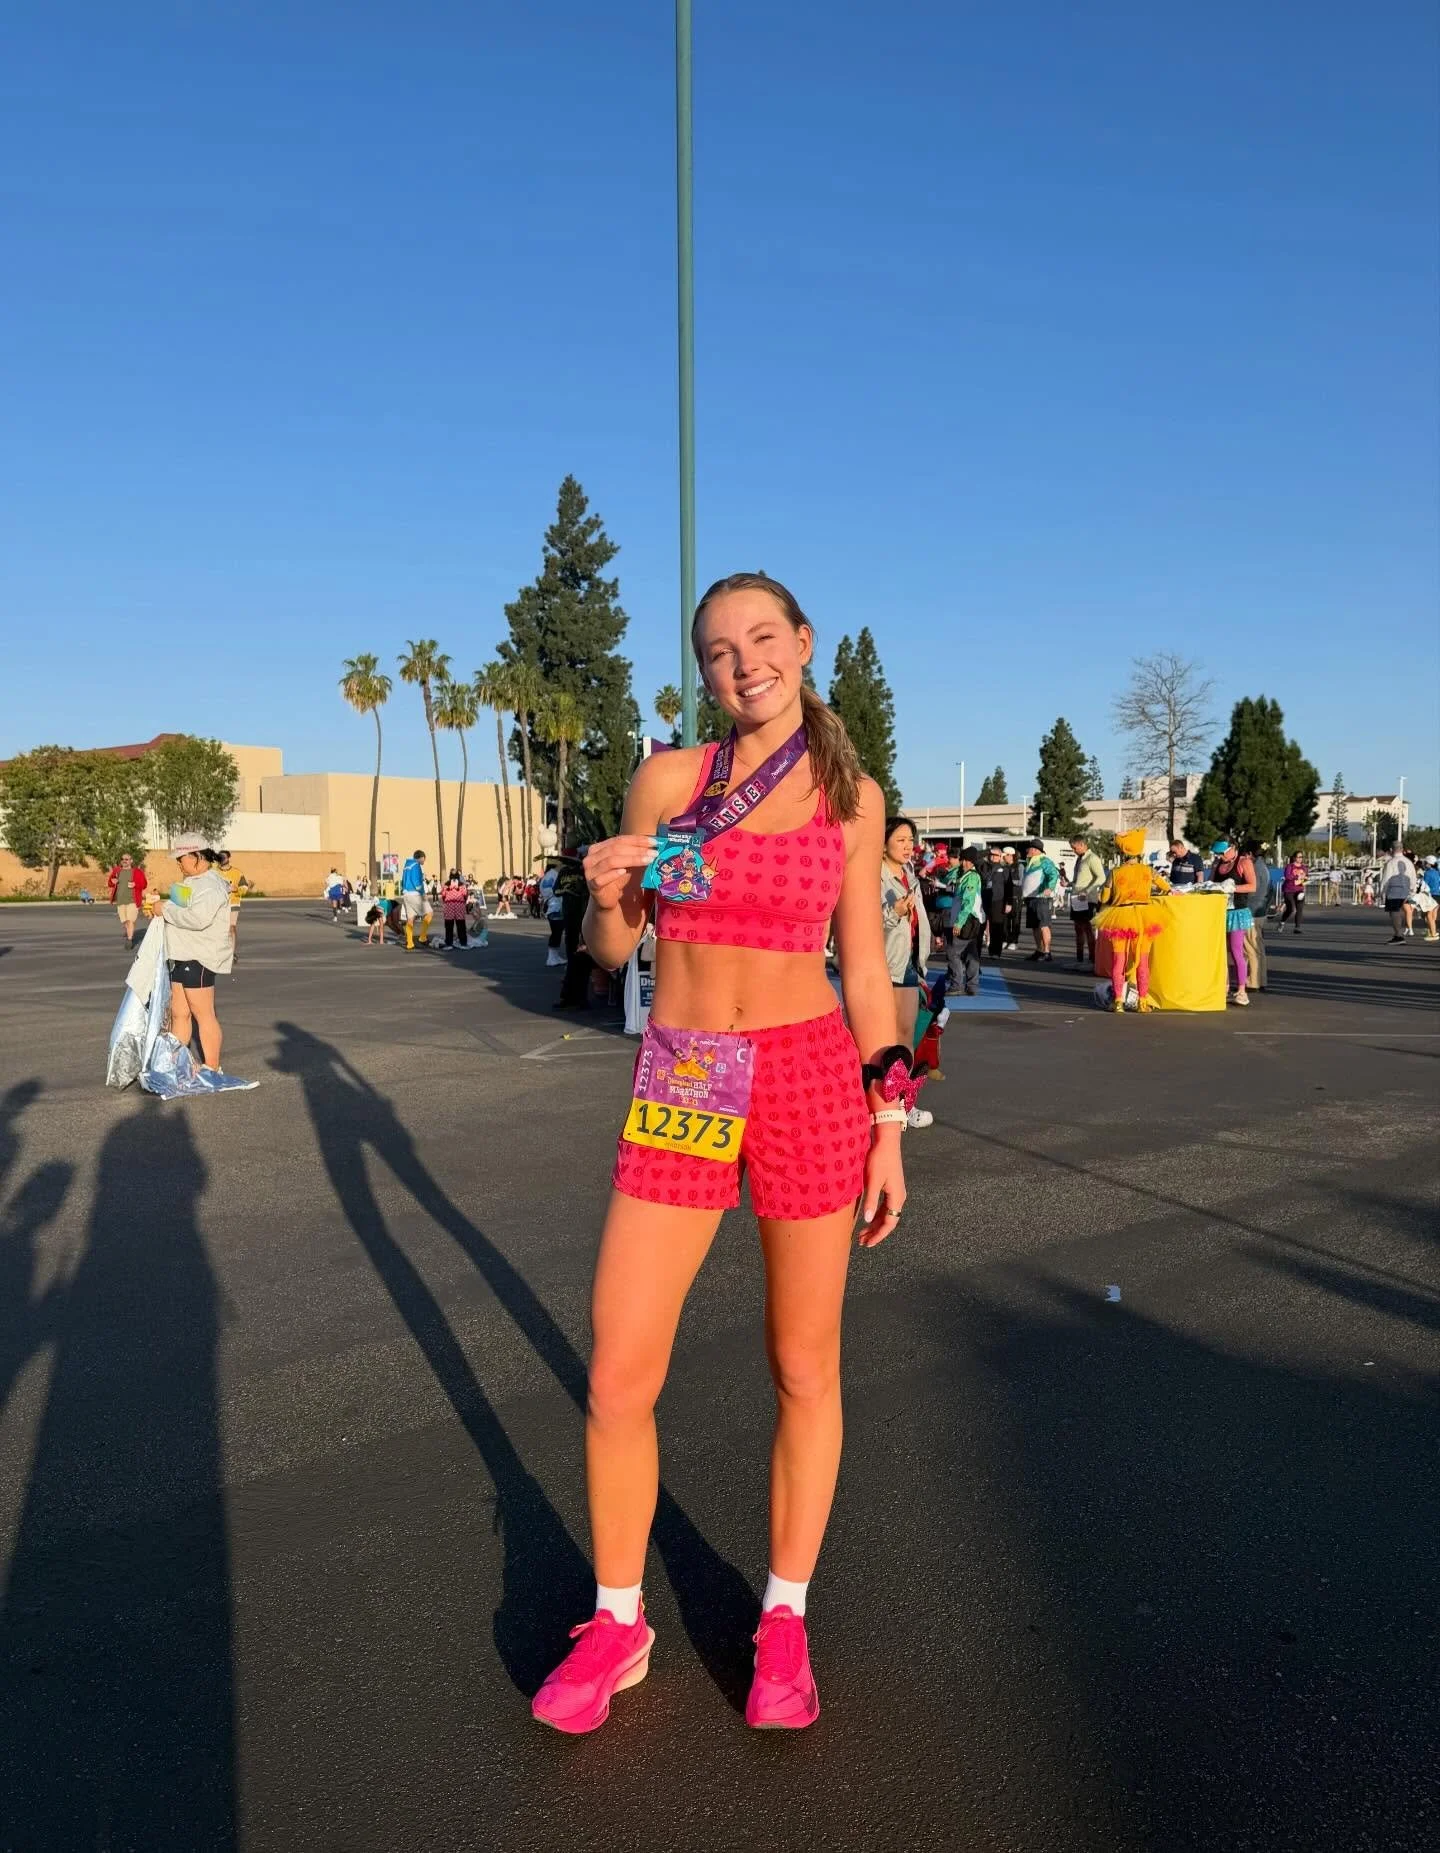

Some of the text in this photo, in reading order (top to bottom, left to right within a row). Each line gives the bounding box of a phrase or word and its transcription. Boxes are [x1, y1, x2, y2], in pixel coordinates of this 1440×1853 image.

[711, 779, 766, 829] FINISHER
[736, 1047, 747, 1064] C
[638, 1050, 653, 1092] 12373
[670, 1085, 709, 1099] MARATHON
[693, 1081, 713, 1091] HALF
[636, 1103, 735, 1149] 12373
